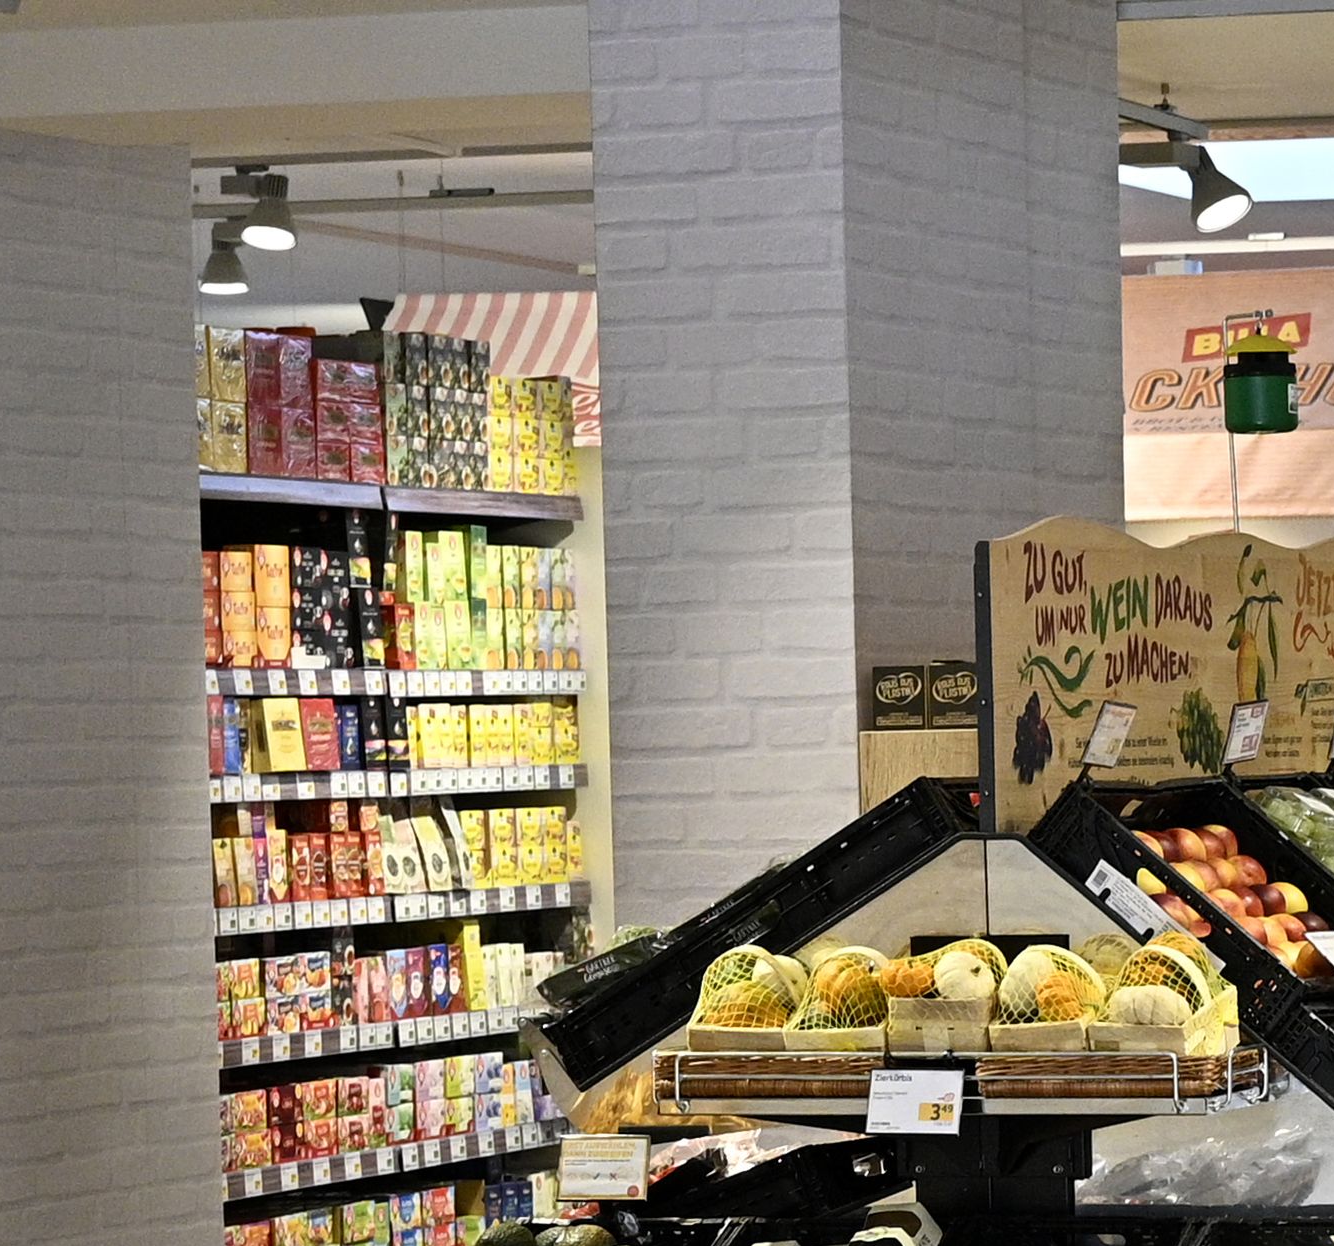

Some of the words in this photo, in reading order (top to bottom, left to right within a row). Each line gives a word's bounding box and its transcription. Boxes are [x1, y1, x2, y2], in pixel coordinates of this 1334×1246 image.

[1192, 321, 1301, 356] BIA
[1023, 540, 1046, 604] ZU
[1051, 550, 1087, 596] GUT,
[1035, 605, 1055, 647] UM
[1059, 604, 1087, 635] NUR
[1090, 575, 1149, 645] WEIN
[1155, 572, 1213, 632] DARAUS
[1104, 650, 1125, 688] ZU
[1127, 632, 1192, 685] MACHEN.
